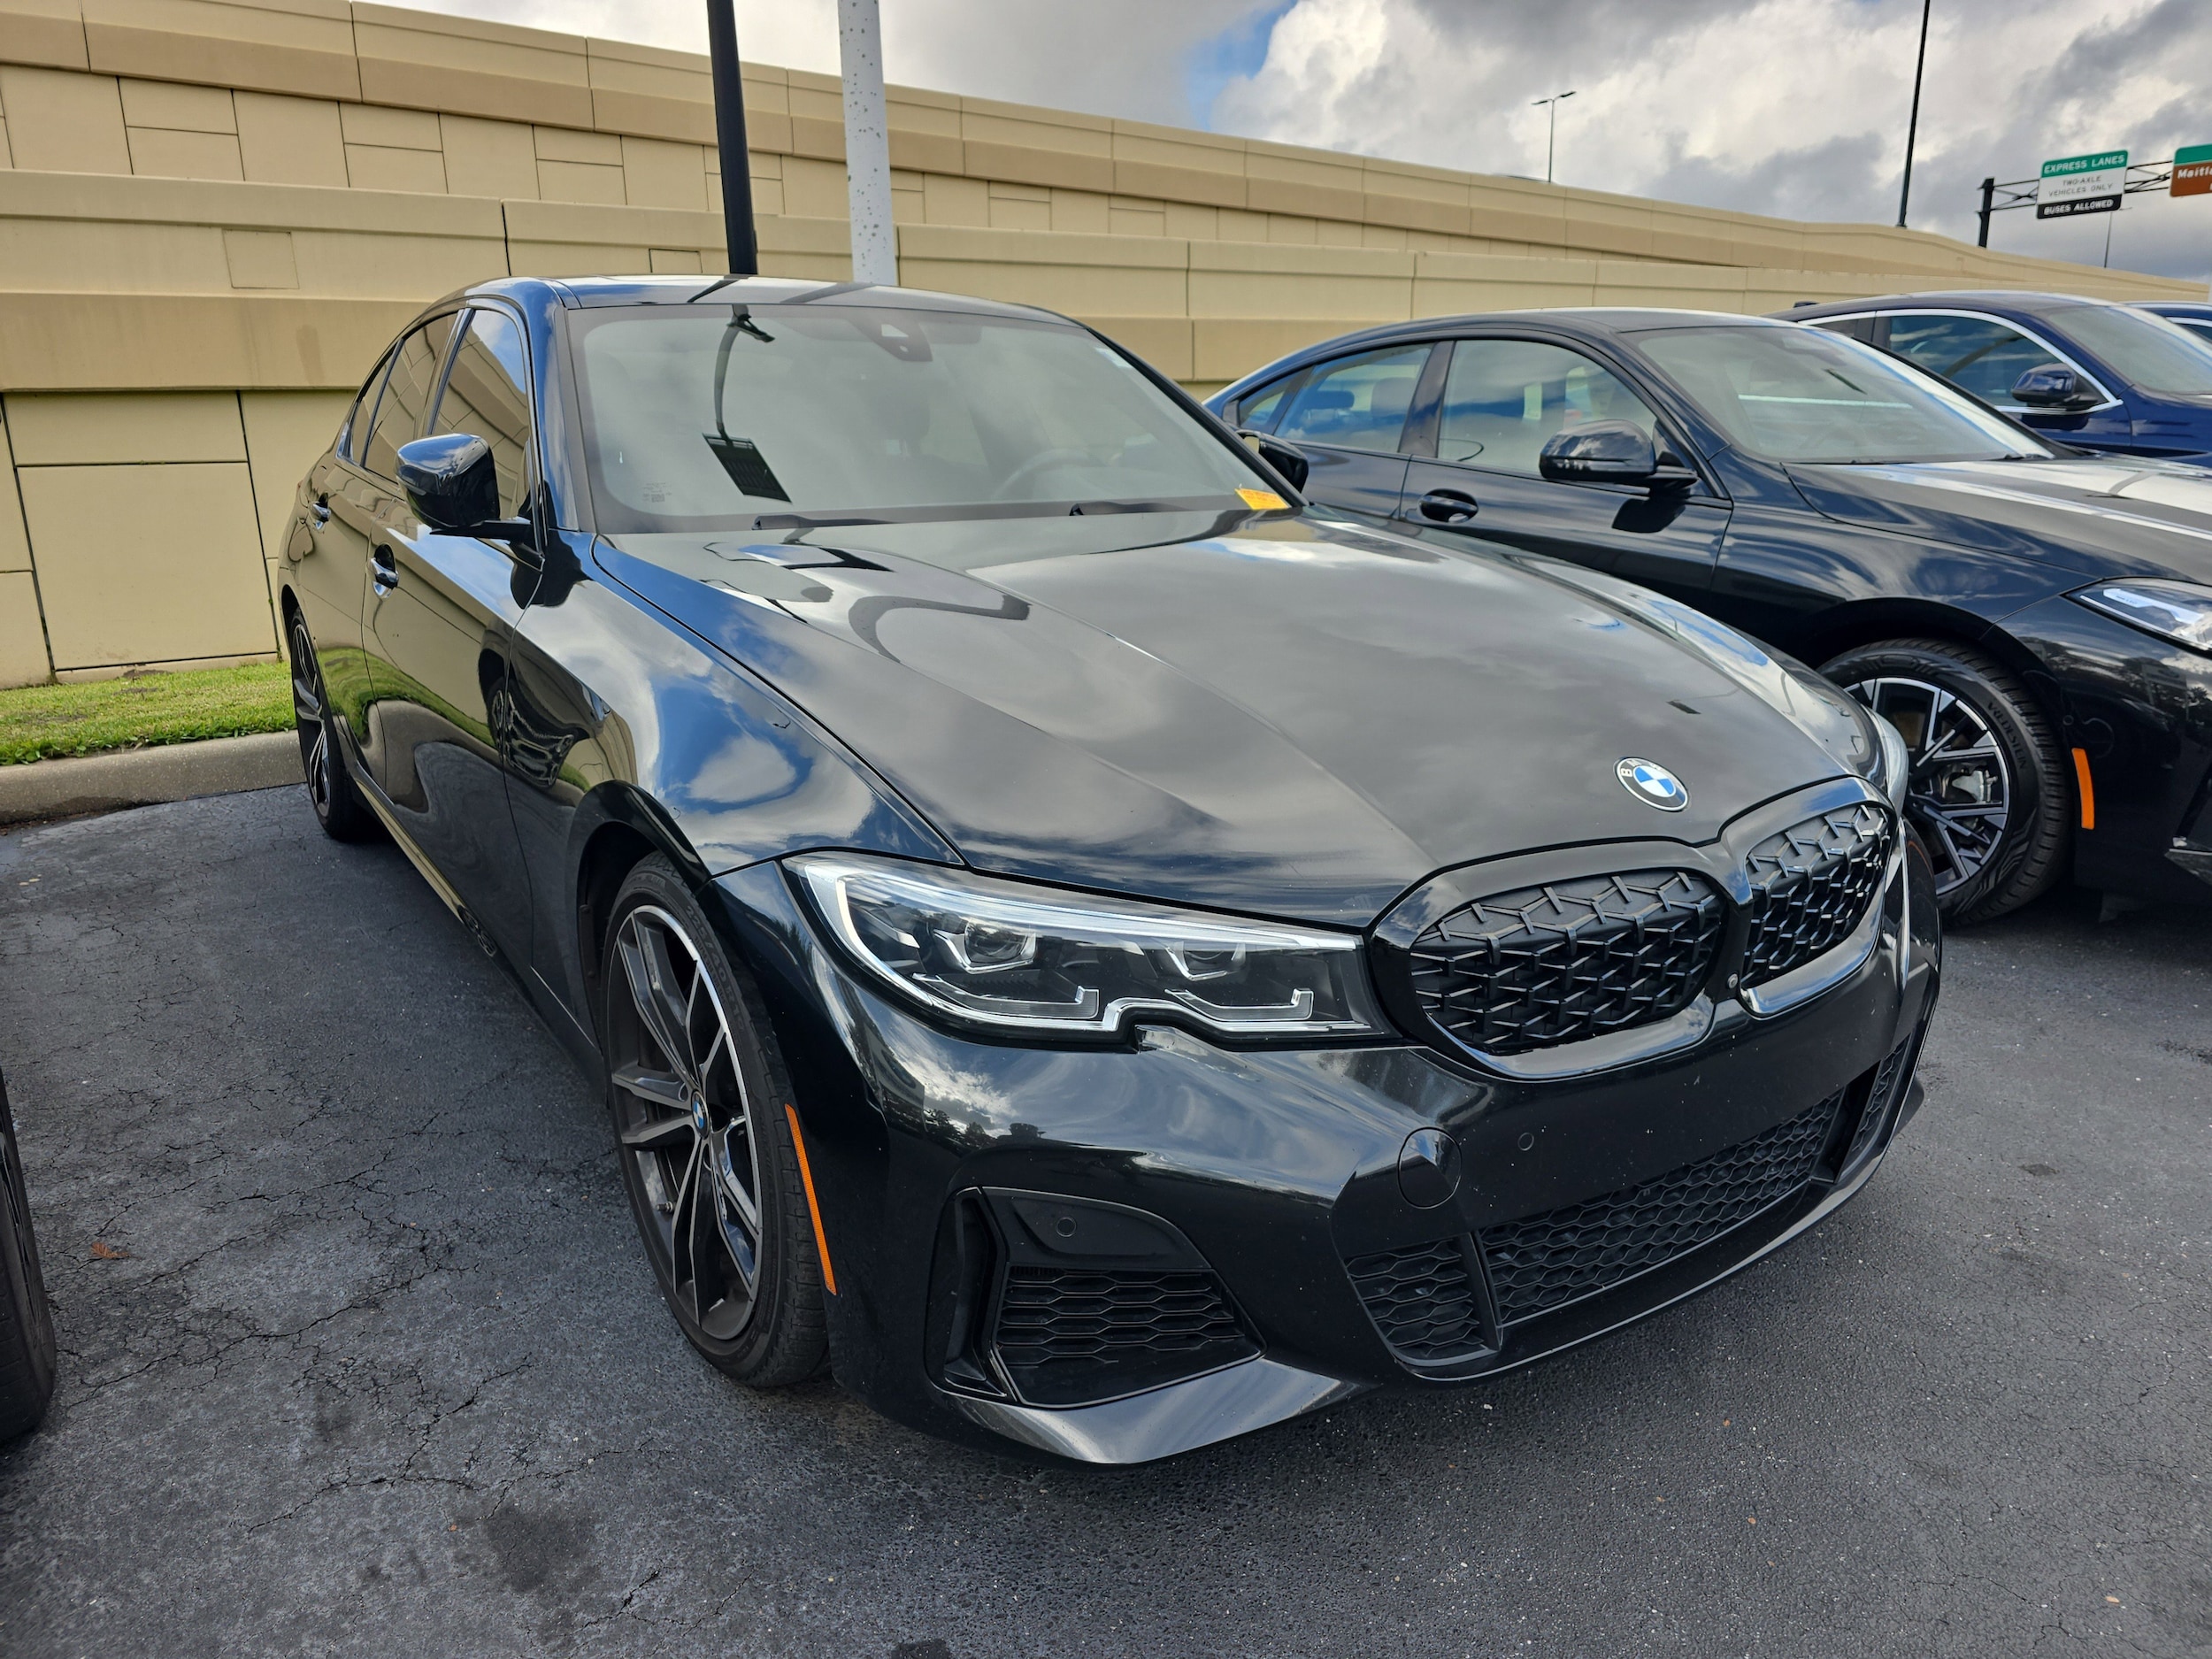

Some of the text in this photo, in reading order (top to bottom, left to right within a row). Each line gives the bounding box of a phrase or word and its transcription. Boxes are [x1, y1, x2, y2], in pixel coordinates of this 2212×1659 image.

[2044, 155, 2124, 174] EXPRESS LANES
[2062, 175, 2102, 186] TWO-AXLE
[2048, 183, 2113, 197] VEHICLES ONLY
[2043, 199, 2114, 215] BUSES ALLOWED
